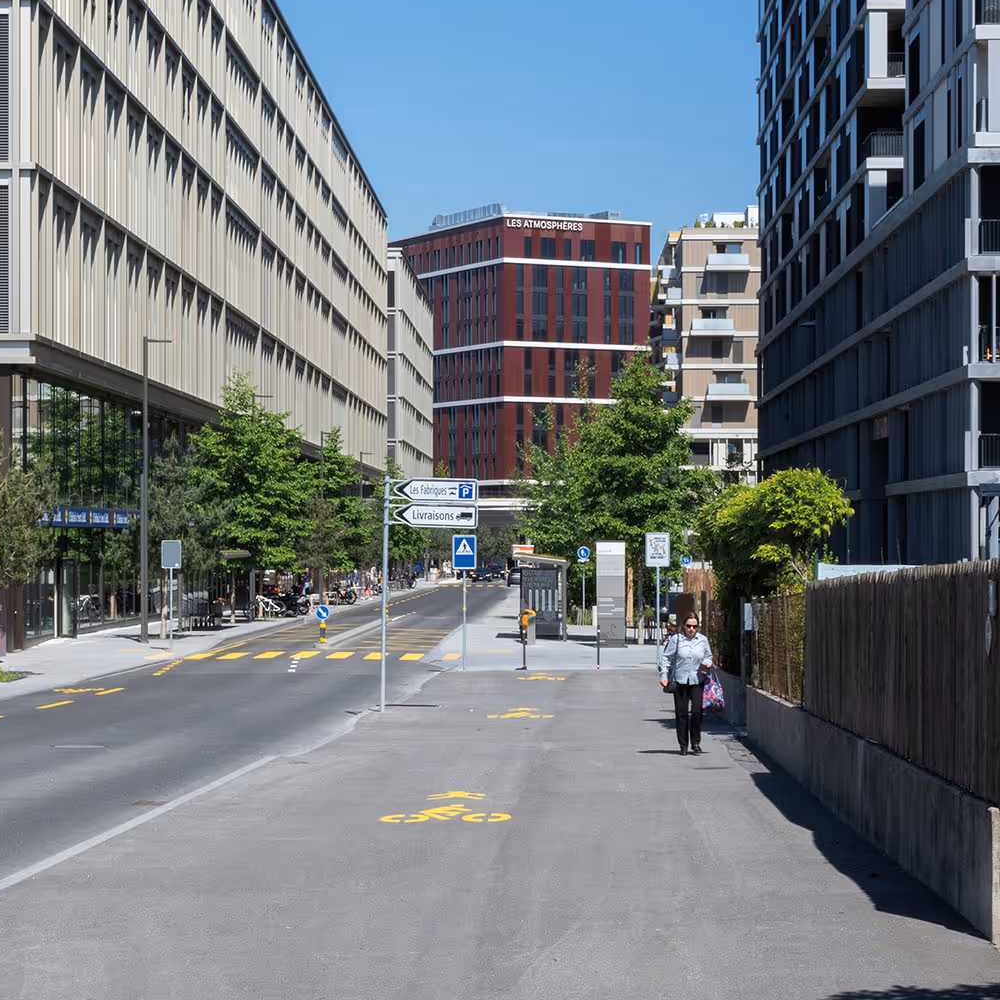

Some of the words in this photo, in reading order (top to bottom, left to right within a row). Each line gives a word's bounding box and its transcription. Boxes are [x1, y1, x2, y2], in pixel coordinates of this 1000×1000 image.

[506, 219, 521, 228] LES
[523, 219, 583, 231] ATMOSPHÈRES
[410, 484, 419, 494] Les
[420, 484, 447, 497] Fabriques
[462, 488, 469, 497] P
[412, 509, 454, 520] Livraisons
